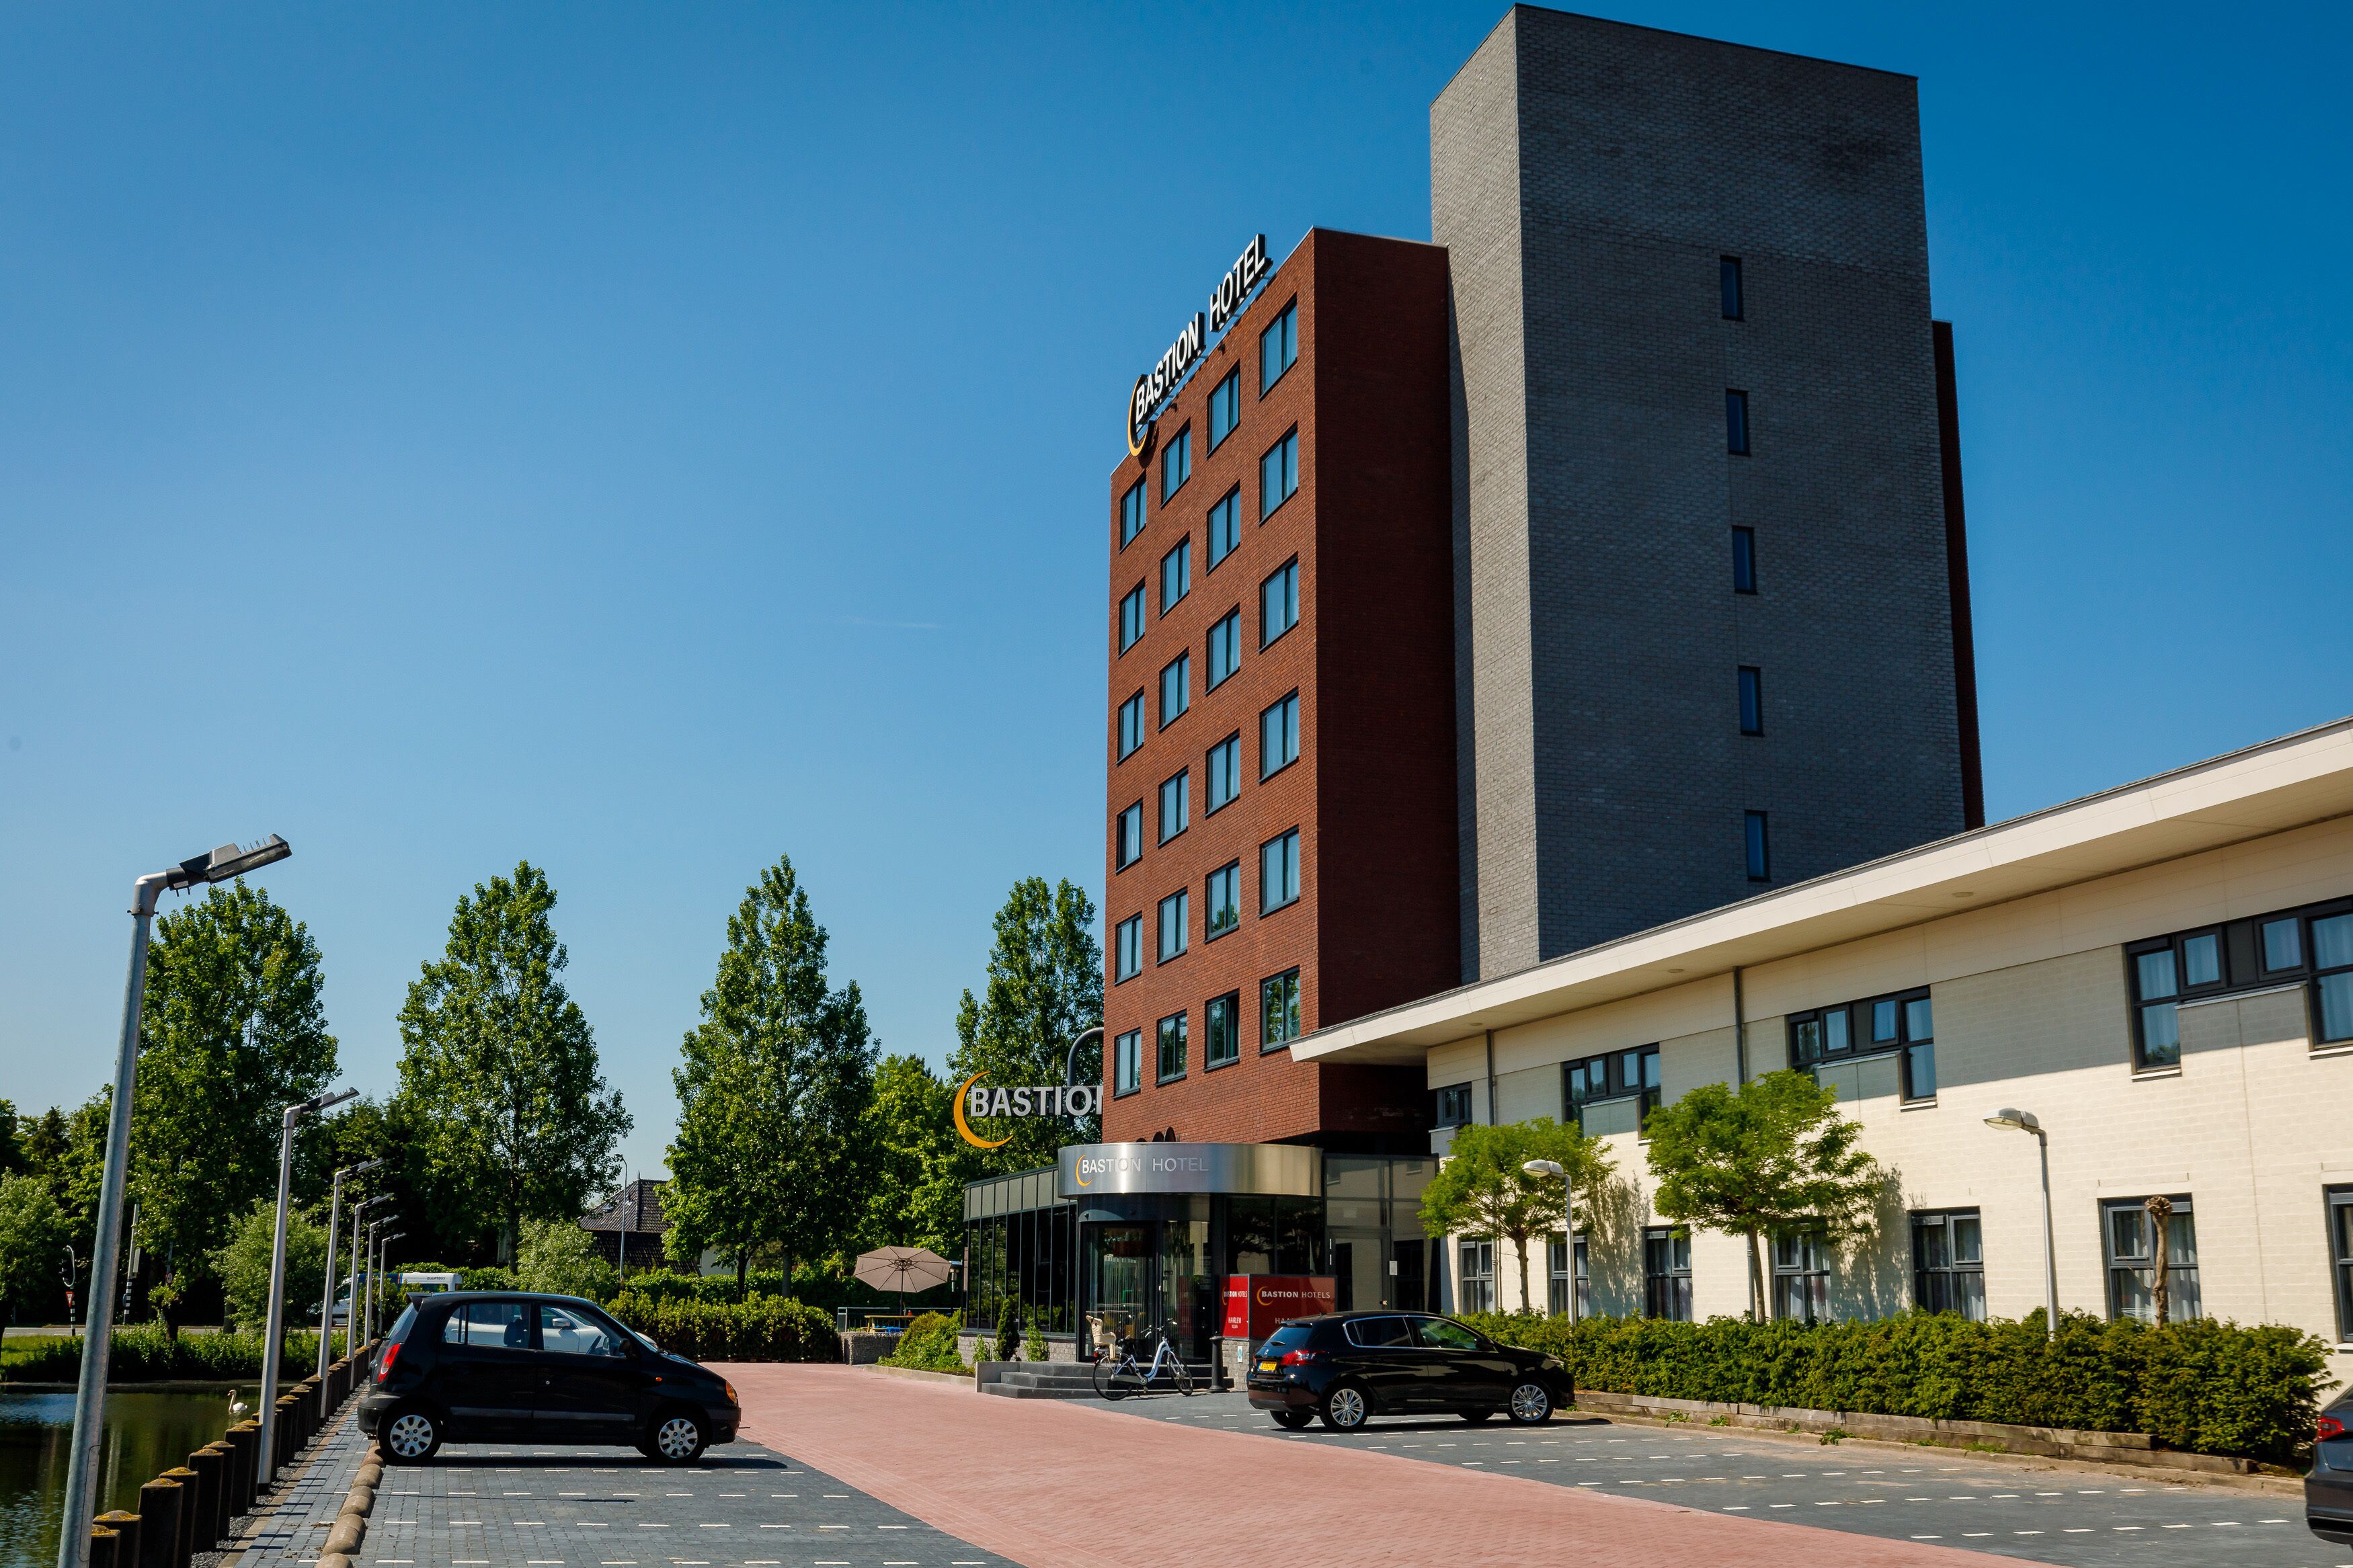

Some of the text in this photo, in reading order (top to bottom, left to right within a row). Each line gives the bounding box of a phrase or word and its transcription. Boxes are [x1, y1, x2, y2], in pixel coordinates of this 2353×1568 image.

[1135, 234, 1267, 425] BASTION HOTEL
[1082, 1157, 1209, 1174] BASTION HOTEL
